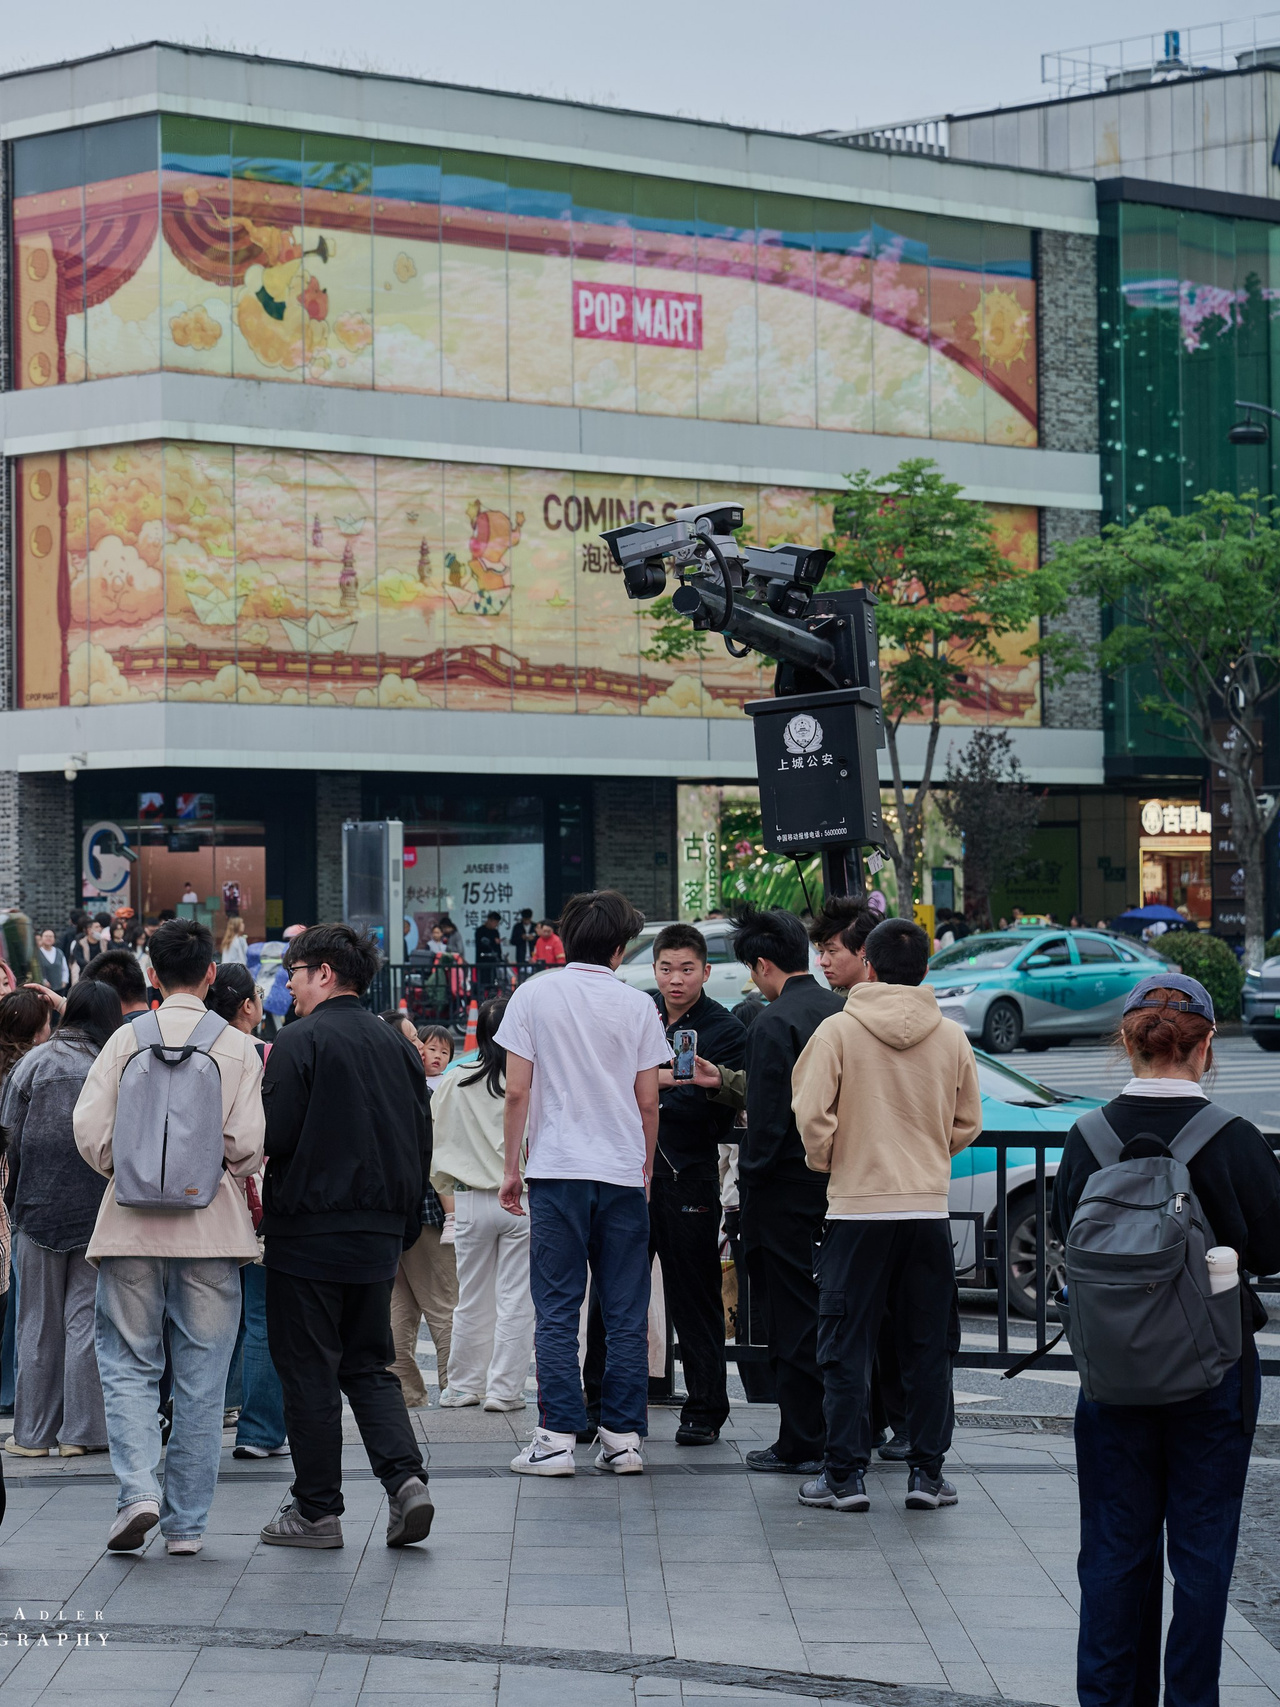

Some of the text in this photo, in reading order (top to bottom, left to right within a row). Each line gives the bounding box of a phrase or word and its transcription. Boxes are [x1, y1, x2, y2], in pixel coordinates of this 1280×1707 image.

[578, 289, 697, 343] POP MART
[543, 494, 656, 533] COMING
[777, 753, 834, 771] 上城公安
[462, 881, 513, 905] 15分钟
